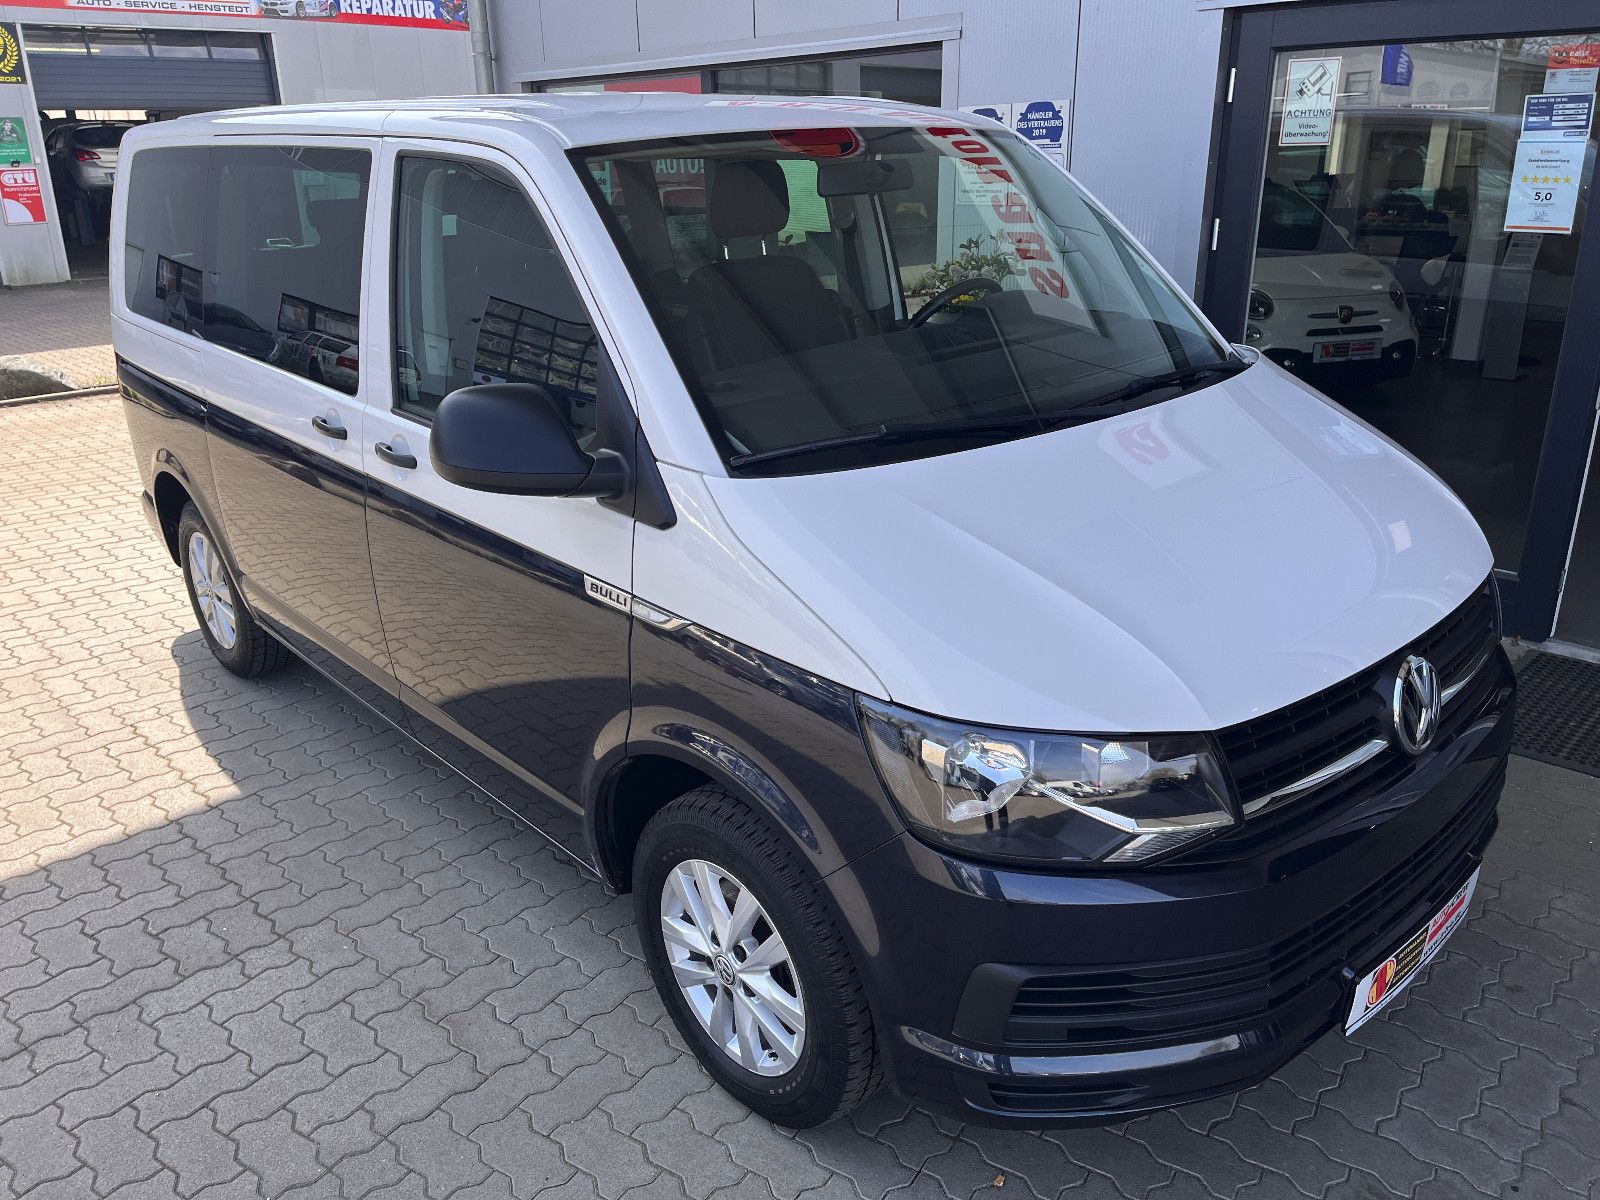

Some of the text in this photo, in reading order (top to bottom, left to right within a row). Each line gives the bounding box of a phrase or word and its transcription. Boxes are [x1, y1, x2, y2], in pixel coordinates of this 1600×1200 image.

[124, 0, 178, 10] SERVICE
[189, 3, 250, 14] HENSTEDT
[340, 0, 437, 19] REPARATUR
[1028, 111, 1053, 120] HÄNDLER
[1286, 109, 1332, 118] ACHTUNG
[1028, 119, 1063, 128] VERTRAUENS
[1033, 129, 1047, 137] 2019
[1534, 191, 1553, 202] 5,0
[590, 582, 627, 607] BULLI
